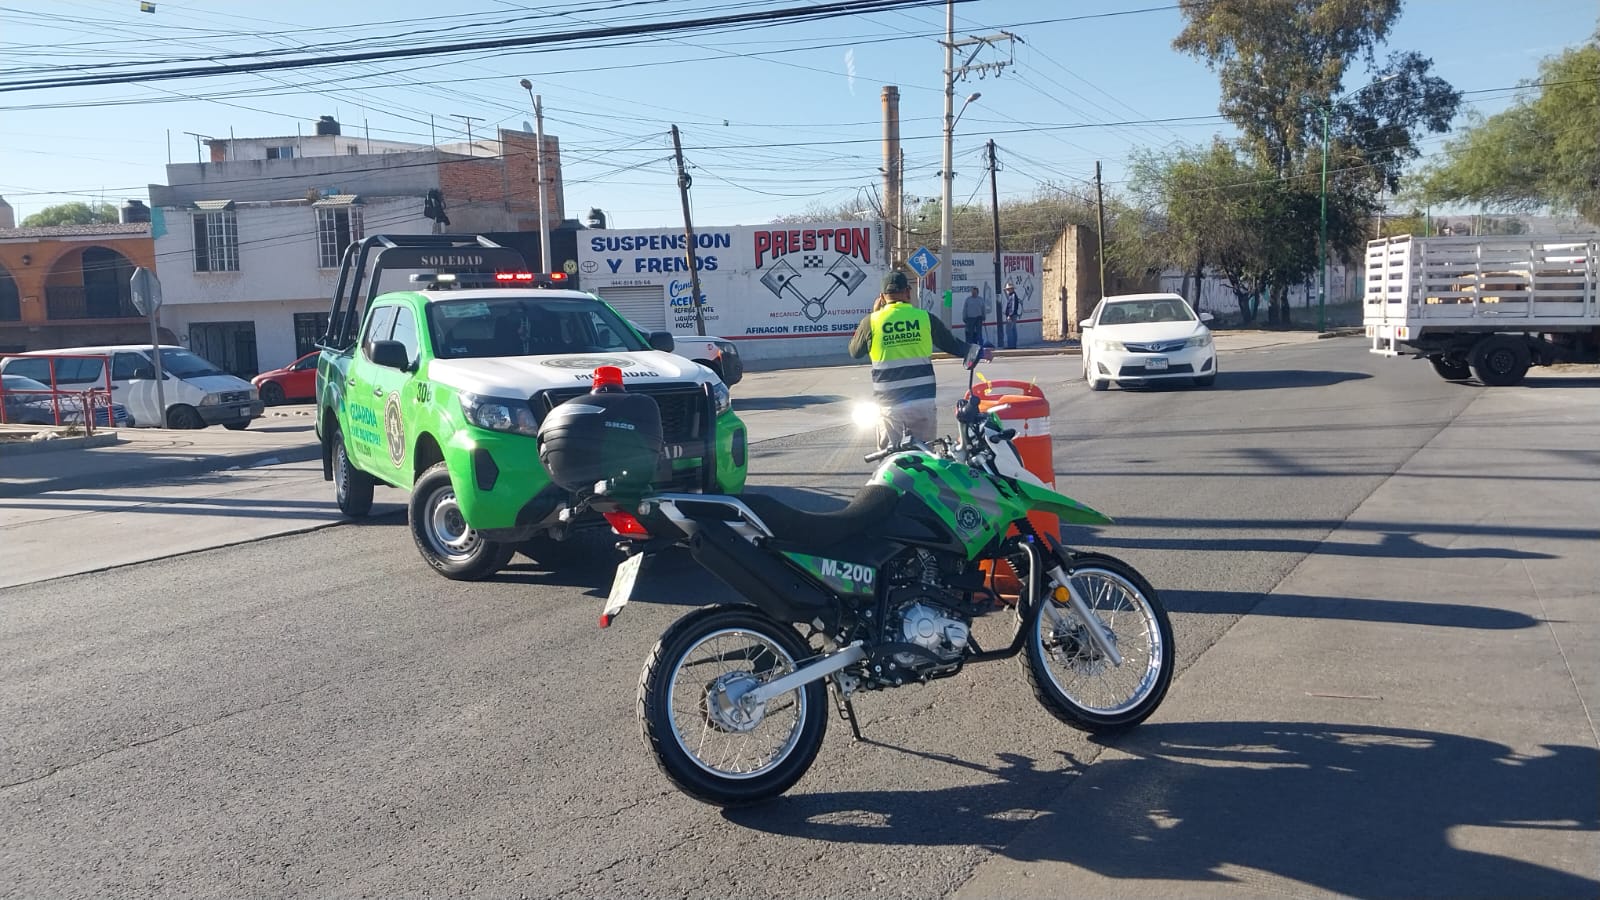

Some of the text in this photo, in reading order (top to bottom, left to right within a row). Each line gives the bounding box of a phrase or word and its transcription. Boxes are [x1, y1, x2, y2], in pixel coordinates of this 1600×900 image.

[591, 233, 731, 251] SUSPENSION
[754, 227, 871, 270] PRESTON
[421, 255, 483, 265] SOLEDAD
[606, 255, 718, 273] Y FRENOS
[1003, 255, 1035, 277] PRESTON
[670, 294, 707, 306] ACEIE
[745, 323, 858, 334] AFINACION FRENOS SUSPE
[882, 319, 920, 334] GCM
[883, 332, 921, 341] GUARDIA
[821, 559, 873, 584] M-200
